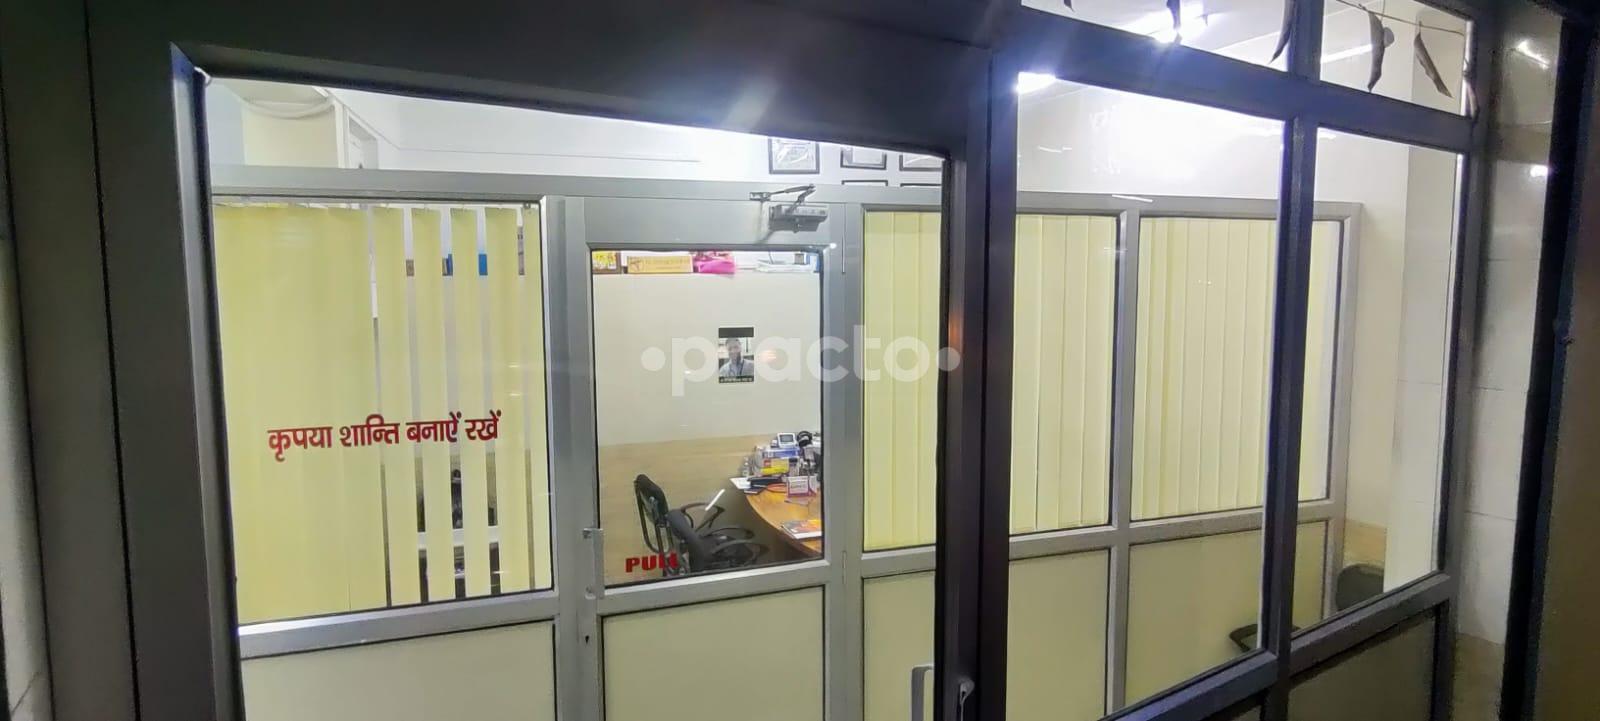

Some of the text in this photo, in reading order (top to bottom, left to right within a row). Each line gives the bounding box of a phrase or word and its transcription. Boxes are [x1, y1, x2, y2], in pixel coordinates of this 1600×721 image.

[267, 409, 502, 462] कृपया शान्ति बनाऐं रखें
[625, 551, 680, 573] PULL
